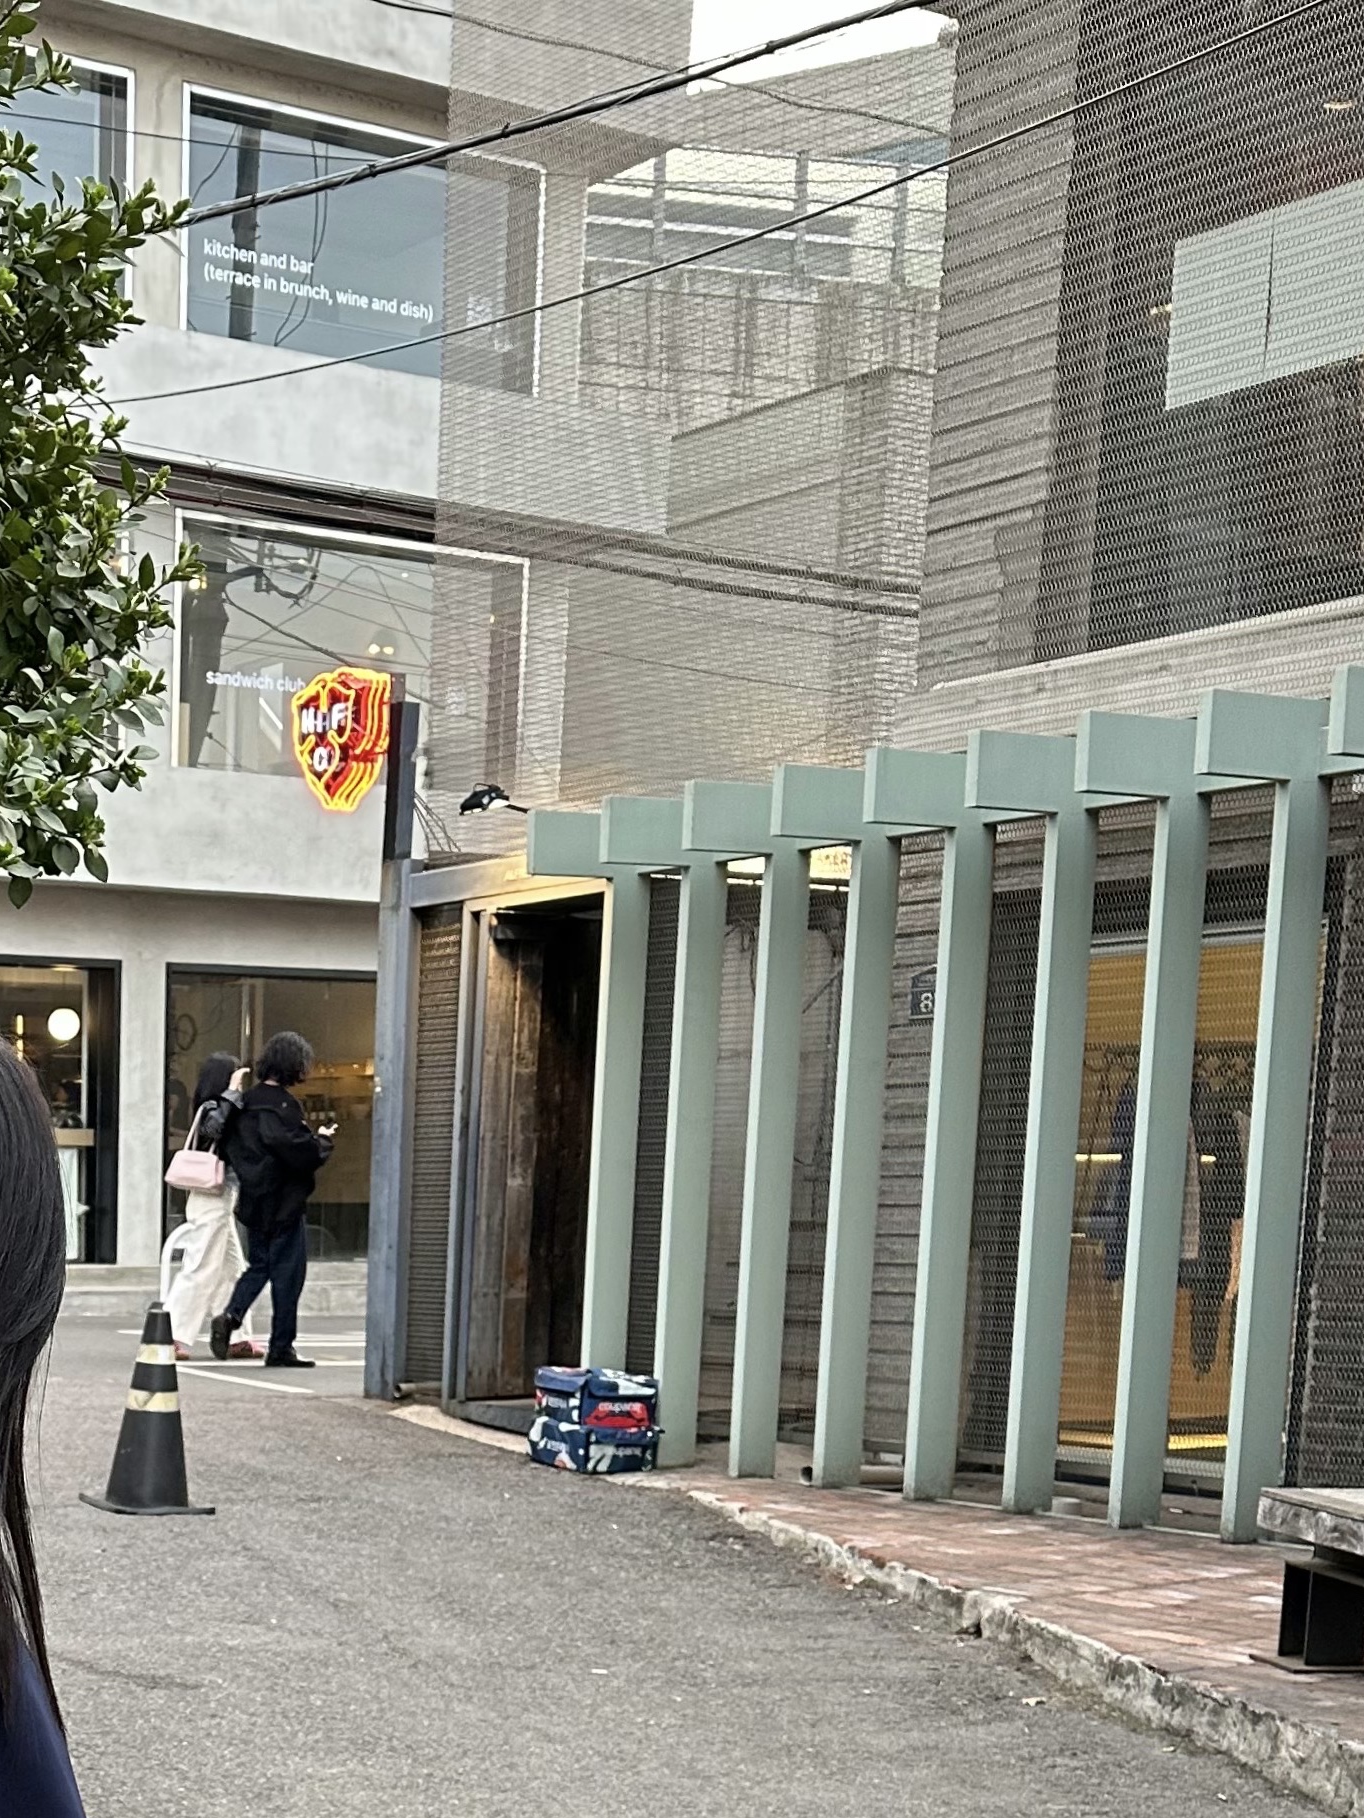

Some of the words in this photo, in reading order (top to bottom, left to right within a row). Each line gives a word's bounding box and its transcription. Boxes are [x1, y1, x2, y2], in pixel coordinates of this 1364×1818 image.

[203, 239, 257, 264] kitchen
[260, 252, 287, 270] and
[290, 256, 315, 275] bar
[203, 262, 260, 289] (terrace
[263, 271, 277, 291] in
[279, 274, 334, 306] brunch,
[335, 290, 369, 308] wine
[371, 293, 398, 314] and
[399, 296, 434, 323] dish)
[206, 670, 274, 690] sandwich
[277, 675, 306, 693] club
